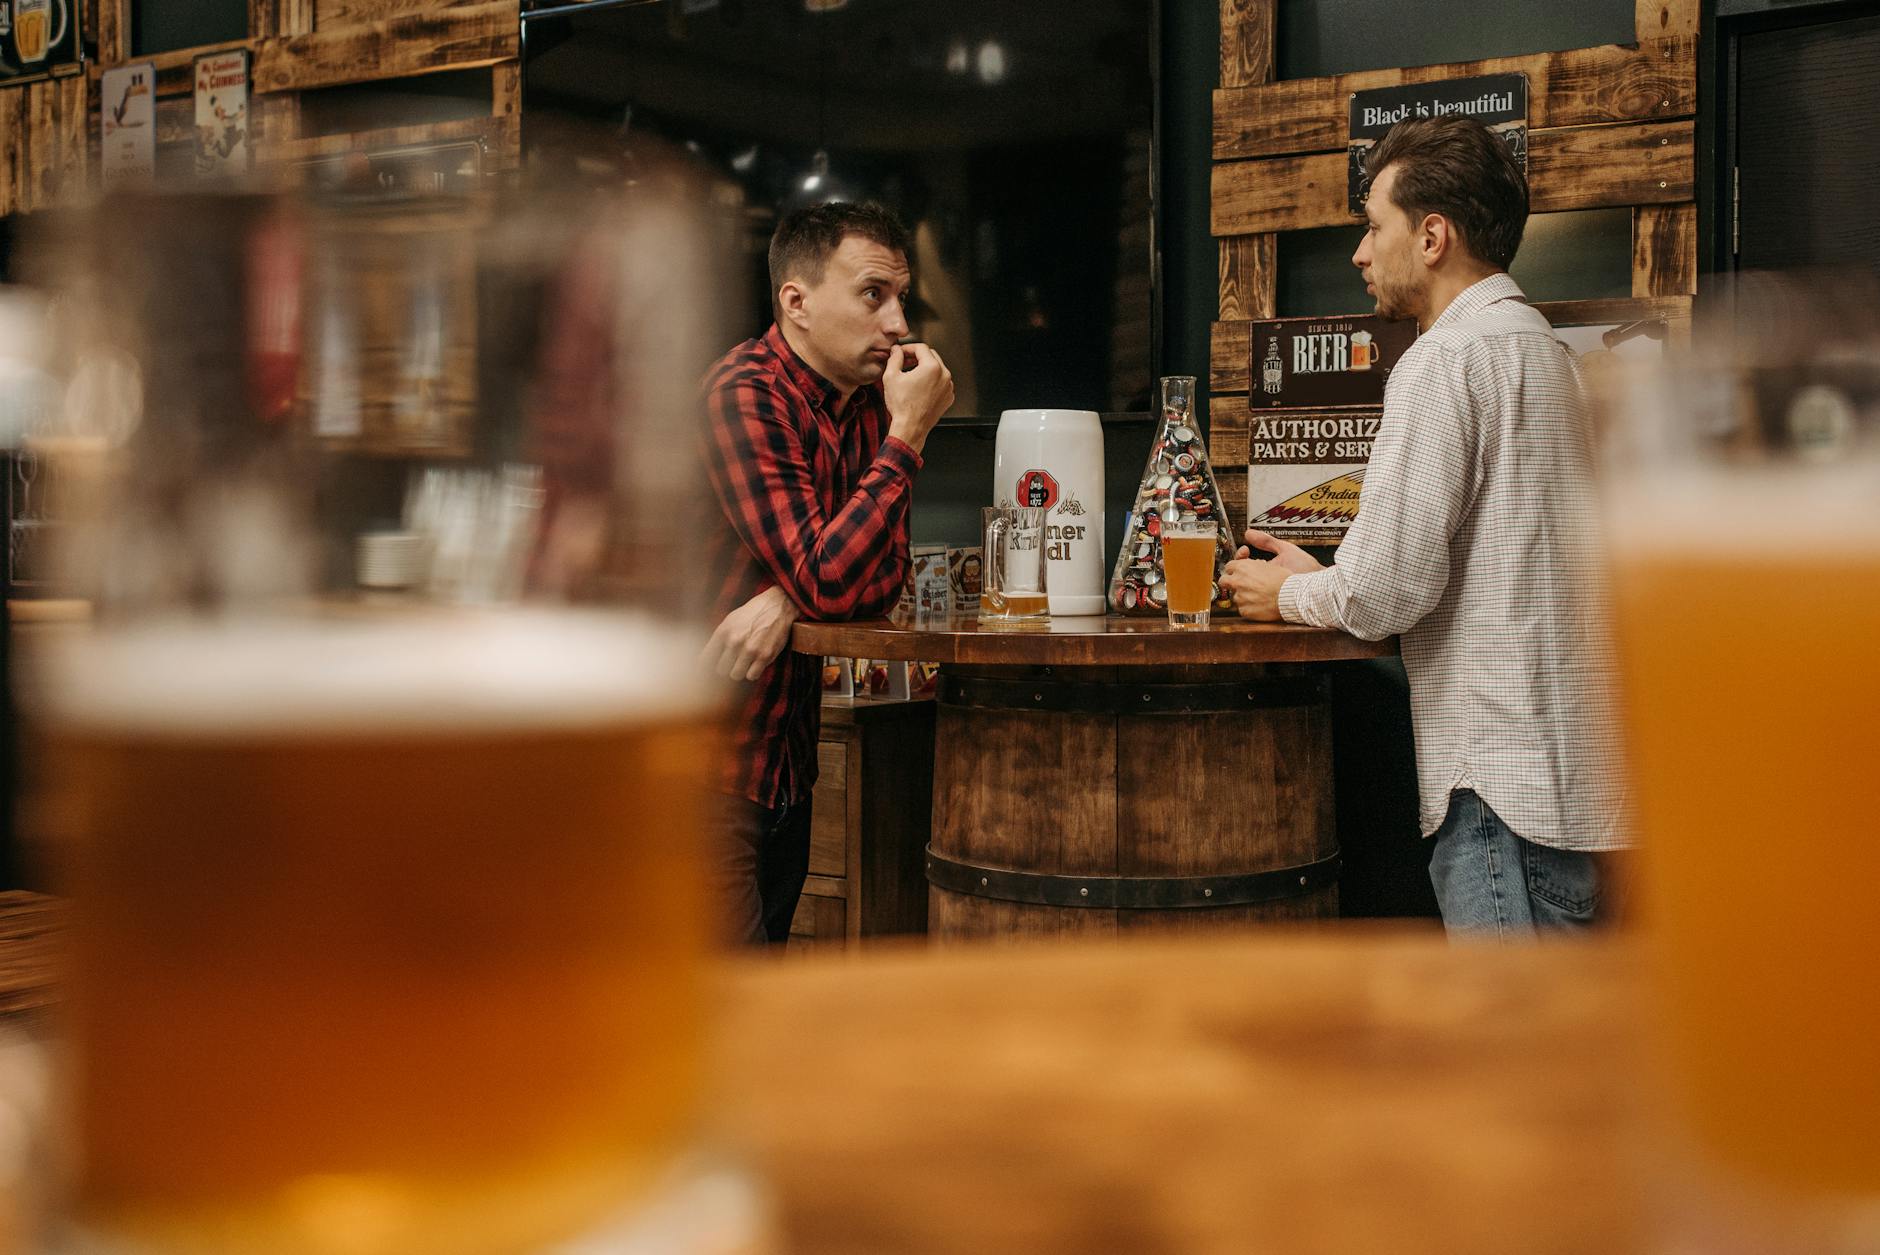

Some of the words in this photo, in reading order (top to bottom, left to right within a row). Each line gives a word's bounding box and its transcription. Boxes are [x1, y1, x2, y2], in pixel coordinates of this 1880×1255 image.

[1363, 103, 1411, 127] Black
[1416, 101, 1429, 118] is
[1308, 324, 1332, 333] SINCE
[1292, 333, 1350, 375] BEER
[1254, 418, 1381, 440] AUTHORIZ
[1254, 442, 1310, 459] PARTS
[1315, 442, 1330, 458] &
[1310, 486, 1360, 500] India
